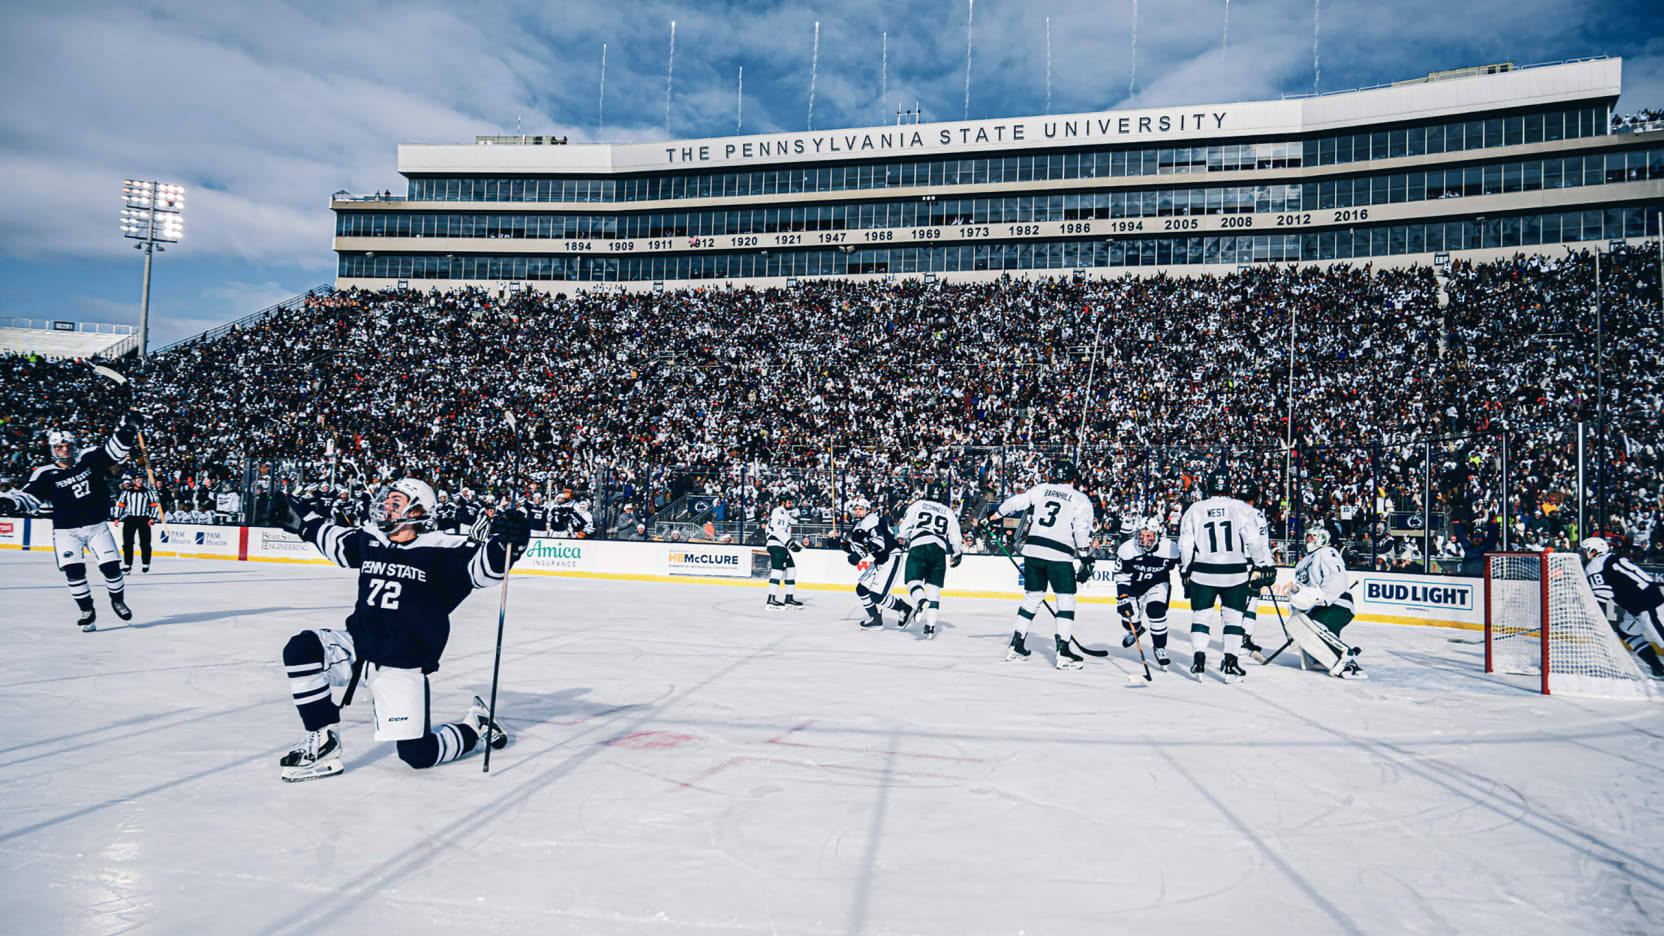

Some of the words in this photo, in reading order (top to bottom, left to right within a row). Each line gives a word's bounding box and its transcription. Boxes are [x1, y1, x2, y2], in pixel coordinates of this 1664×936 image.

[666, 146, 710, 162] THE
[726, 131, 923, 158] PENNSYLVANIA
[939, 124, 1025, 145] STATE
[1044, 112, 1227, 139] UNIVERSITY
[564, 241, 592, 251] 1894
[608, 241, 634, 251] 1909
[648, 240, 673, 249] 1911
[731, 236, 758, 246] 1920
[775, 234, 802, 245] 1921
[818, 233, 847, 243] 1947
[864, 231, 893, 241] 1968
[911, 229, 941, 239] 1969
[959, 227, 990, 238] 1973
[1008, 225, 1040, 236] 1982
[1059, 223, 1091, 234] 1986
[1111, 221, 1143, 232] 1994
[1164, 219, 1199, 230] 2005
[1220, 217, 1253, 228] 2008
[1276, 214, 1312, 226] 2012
[1334, 209, 1369, 222] 2016
[71, 480, 91, 499] 27
[1044, 489, 1073, 502] BARNHILL
[916, 511, 949, 535] 29
[1038, 500, 1061, 527] 3
[1206, 508, 1225, 518] WEST
[1204, 520, 1234, 553] 11
[526, 540, 582, 559] Amica
[361, 560, 387, 575] PENN
[386, 563, 427, 582] STATE
[533, 560, 577, 568] INSURANCE
[1590, 573, 1605, 586] 18
[366, 578, 402, 610] 72
[1367, 582, 1409, 601] BUD
[1411, 585, 1469, 606] LIGHT
